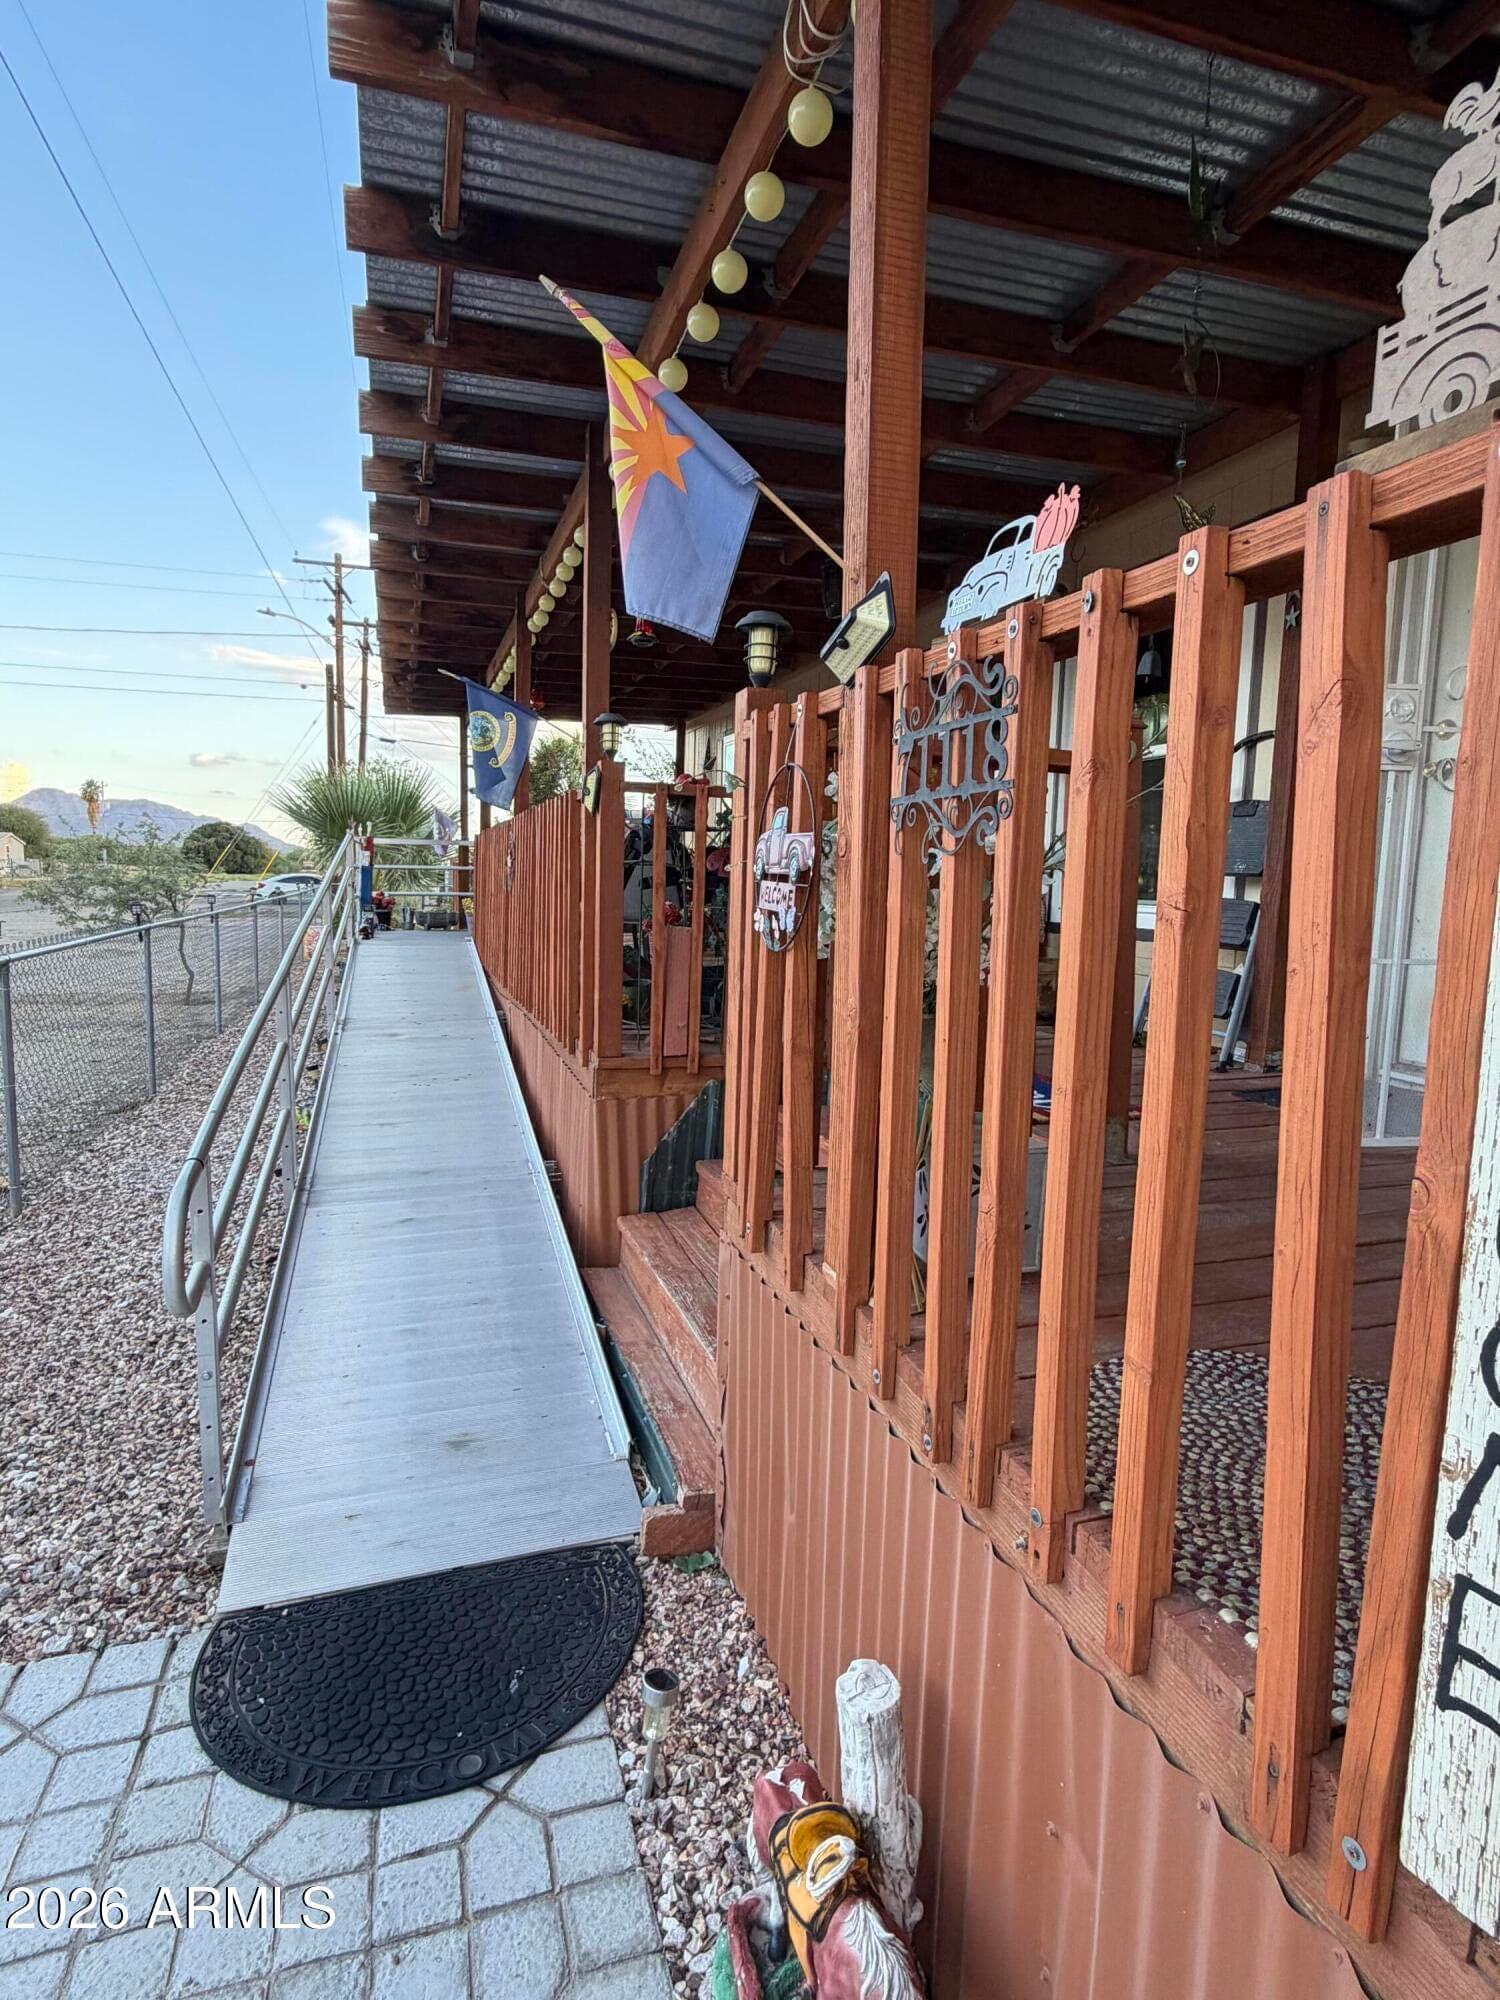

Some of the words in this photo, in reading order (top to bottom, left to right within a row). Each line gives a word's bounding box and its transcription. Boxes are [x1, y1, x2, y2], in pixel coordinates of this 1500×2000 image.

[898, 716, 1008, 801] 7118
[761, 885, 793, 909] WELCOME
[295, 1713, 560, 1799] WELCOME
